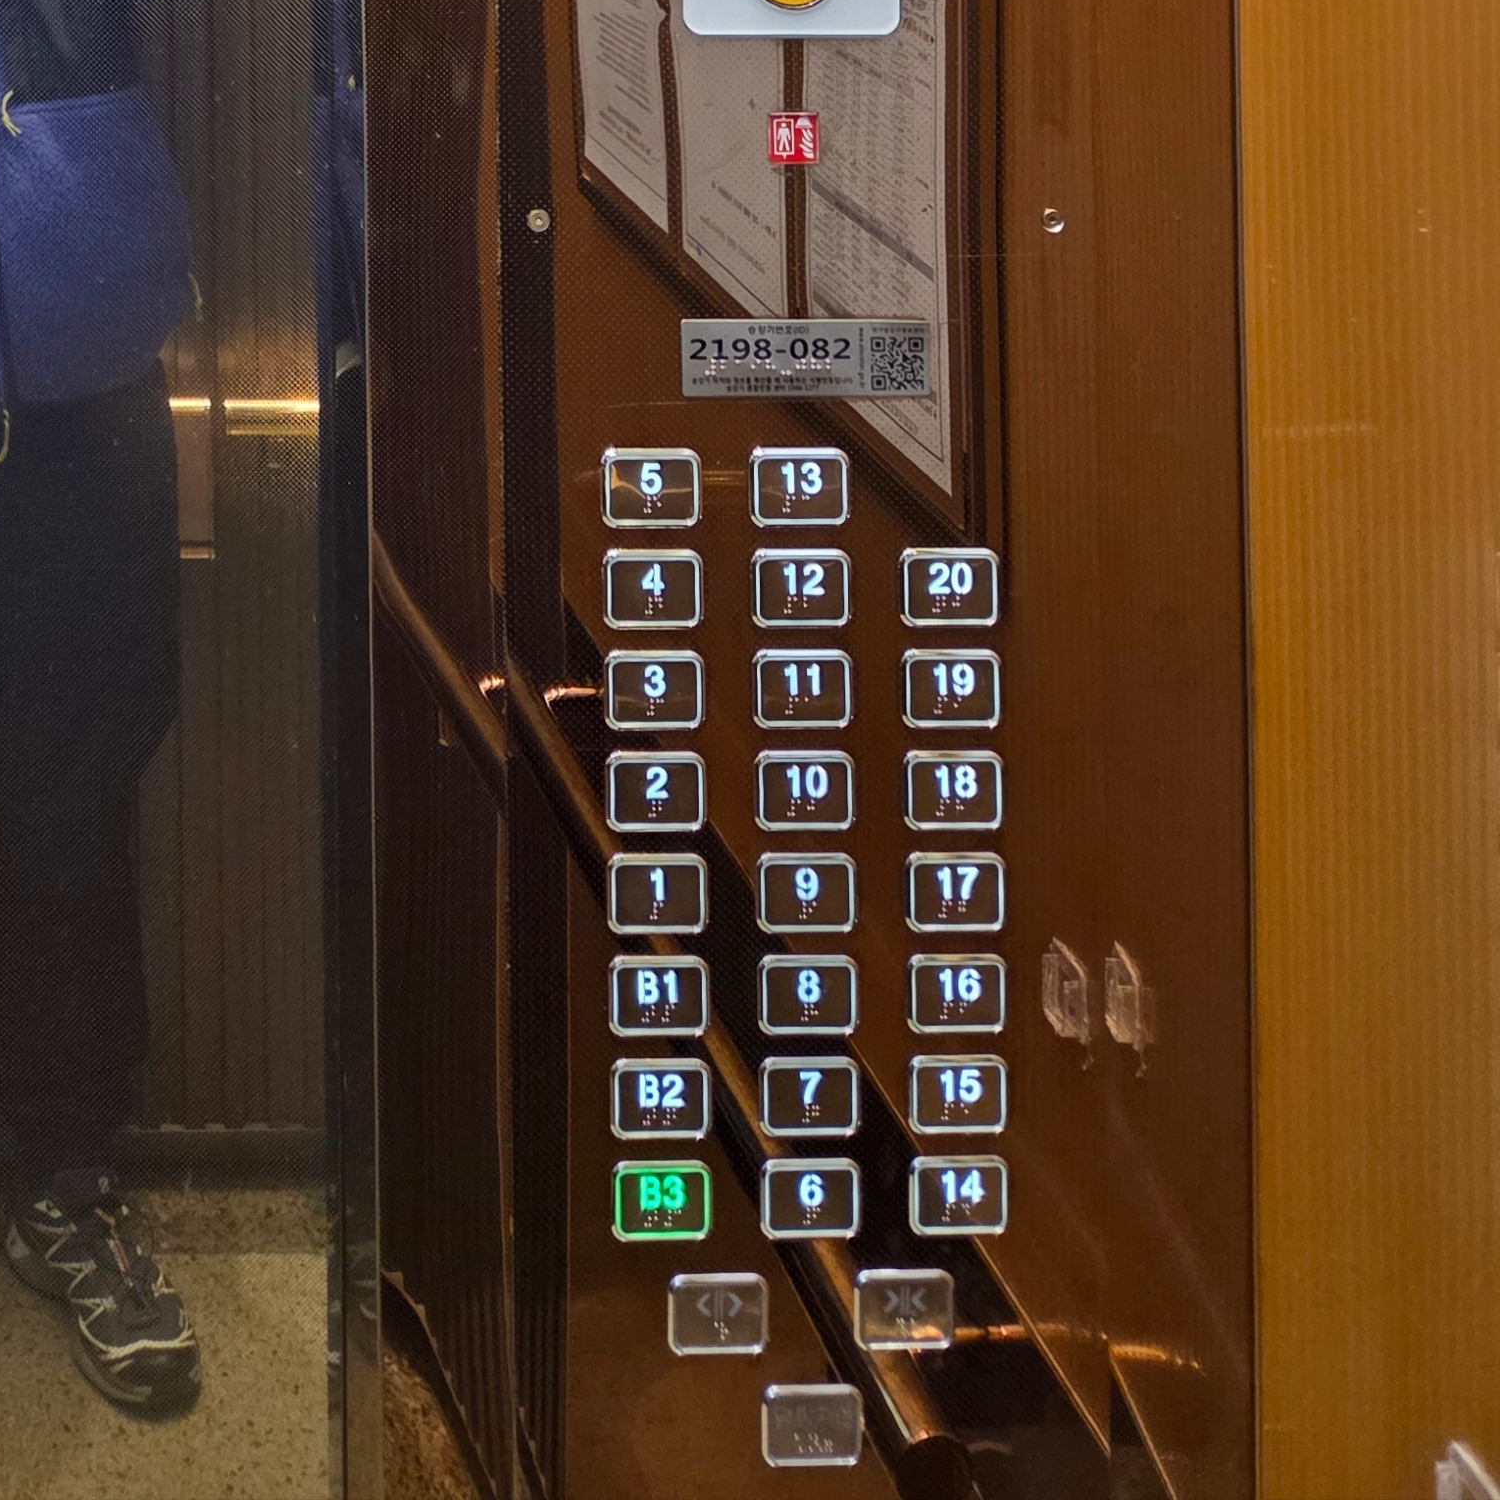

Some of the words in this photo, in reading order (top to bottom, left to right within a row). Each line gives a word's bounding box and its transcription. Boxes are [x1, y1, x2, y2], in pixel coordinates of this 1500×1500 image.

[689, 338, 851, 361] 2198-082
[640, 463, 663, 495] 5
[781, 462, 823, 495] 13
[642, 563, 665, 595] 4
[783, 563, 825, 596] 12
[928, 562, 973, 595] 20
[644, 665, 666, 698] 3
[784, 664, 821, 697] 11
[933, 664, 975, 697] 19
[646, 767, 669, 800] 2
[786, 765, 828, 799] 10
[934, 765, 978, 799] 18
[650, 867, 665, 902] 1
[795, 867, 819, 901] 9
[937, 866, 979, 900] 17
[637, 970, 679, 1005] B1
[798, 969, 822, 1003] 8
[939, 968, 982, 1002] 16
[639, 1074, 685, 1108] B2
[799, 1071, 823, 1105] 7
[940, 1069, 983, 1103] 15
[640, 1175, 687, 1210] B3
[799, 1174, 824, 1207] 6
[942, 1170, 985, 1204] 14
